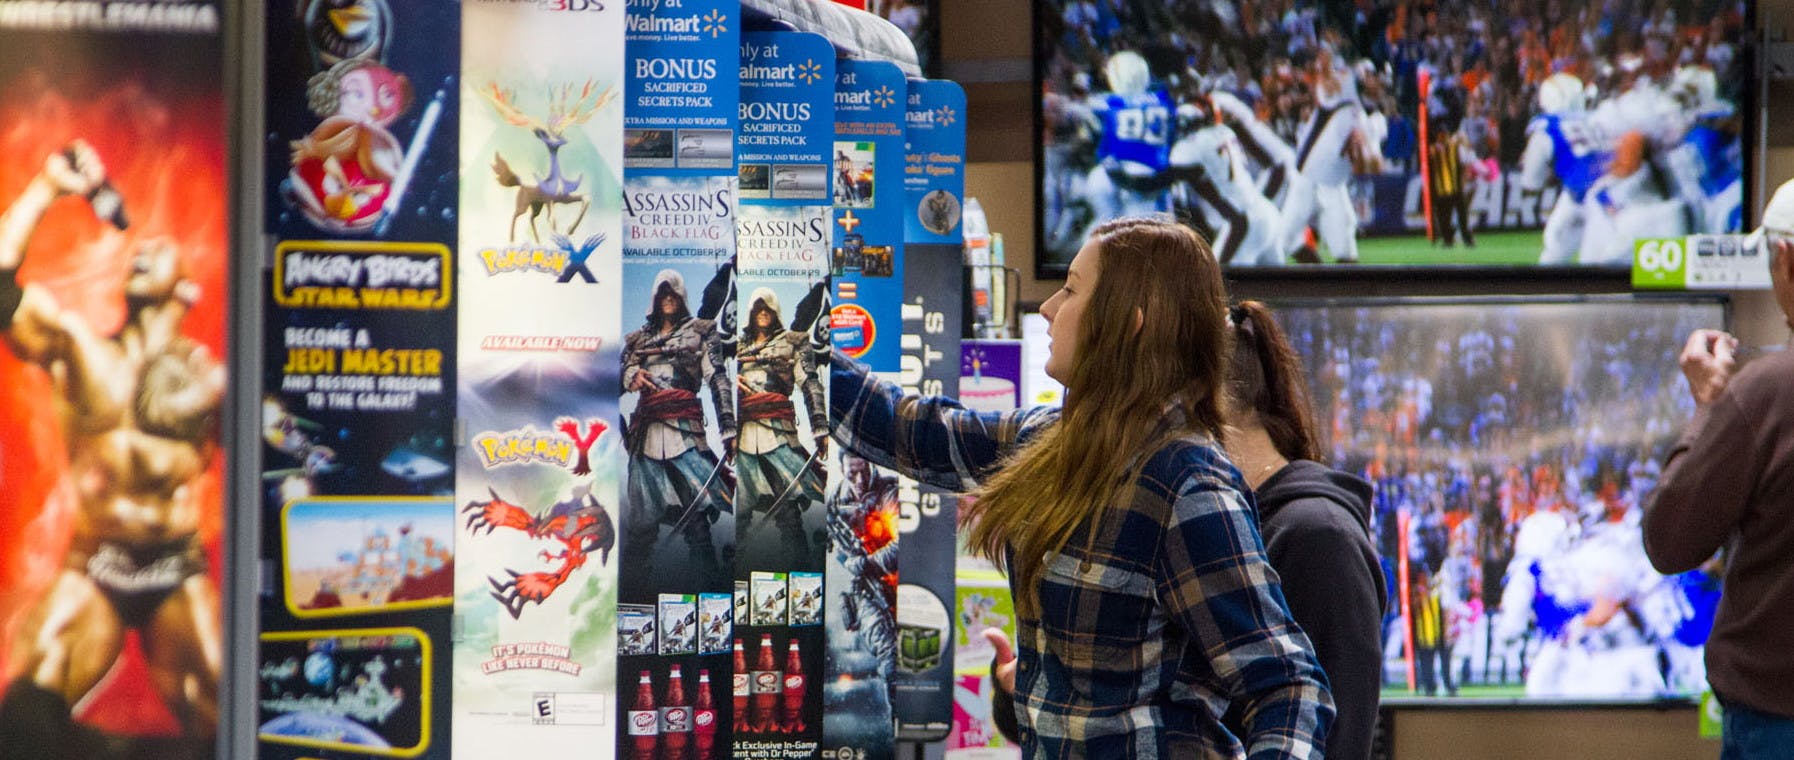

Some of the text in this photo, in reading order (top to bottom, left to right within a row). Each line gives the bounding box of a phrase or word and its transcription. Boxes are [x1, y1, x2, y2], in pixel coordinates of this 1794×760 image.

[624, 14, 700, 33] Walmart
[739, 42, 779, 61] nly at
[635, 58, 717, 80] BONUS
[739, 63, 795, 80] almart
[842, 72, 857, 85] at
[644, 82, 707, 93] SACRIFICED
[637, 96, 713, 107] SECRETS PACK
[834, 89, 871, 104] mart
[738, 102, 811, 121] BONUS
[624, 117, 645, 125] XTRA
[743, 123, 802, 133] SACRIFICED
[738, 135, 807, 145] SECRETS PACK
[639, 214, 712, 226] CREED IV
[631, 226, 721, 241] BLACK FLAG
[738, 238, 805, 249] CREED IV
[672, 248, 715, 257] OCTOBER
[779, 249, 814, 263] FLAG
[1638, 240, 1683, 272] 60
[284, 251, 440, 288] ANGRY BIRDS
[767, 269, 806, 277] OCTOBER
[291, 286, 439, 309] STAR WARS
[284, 327, 370, 348] BECOME A
[481, 336, 602, 352] AVAILABLE NOW
[283, 347, 443, 375] JEDI MASTER
[281, 374, 443, 392] AND RESTORE FREEDOM
[306, 391, 418, 410] TO THE GALAXY!
[555, 419, 608, 477] Y
[481, 656, 582, 677] LIKE NEVER BEFORE
[536, 699, 552, 717] E
[742, 741, 782, 750] Exclusive
[783, 741, 818, 750] In-Game
[750, 750, 769, 758] with
[770, 750, 781, 758] Dr
